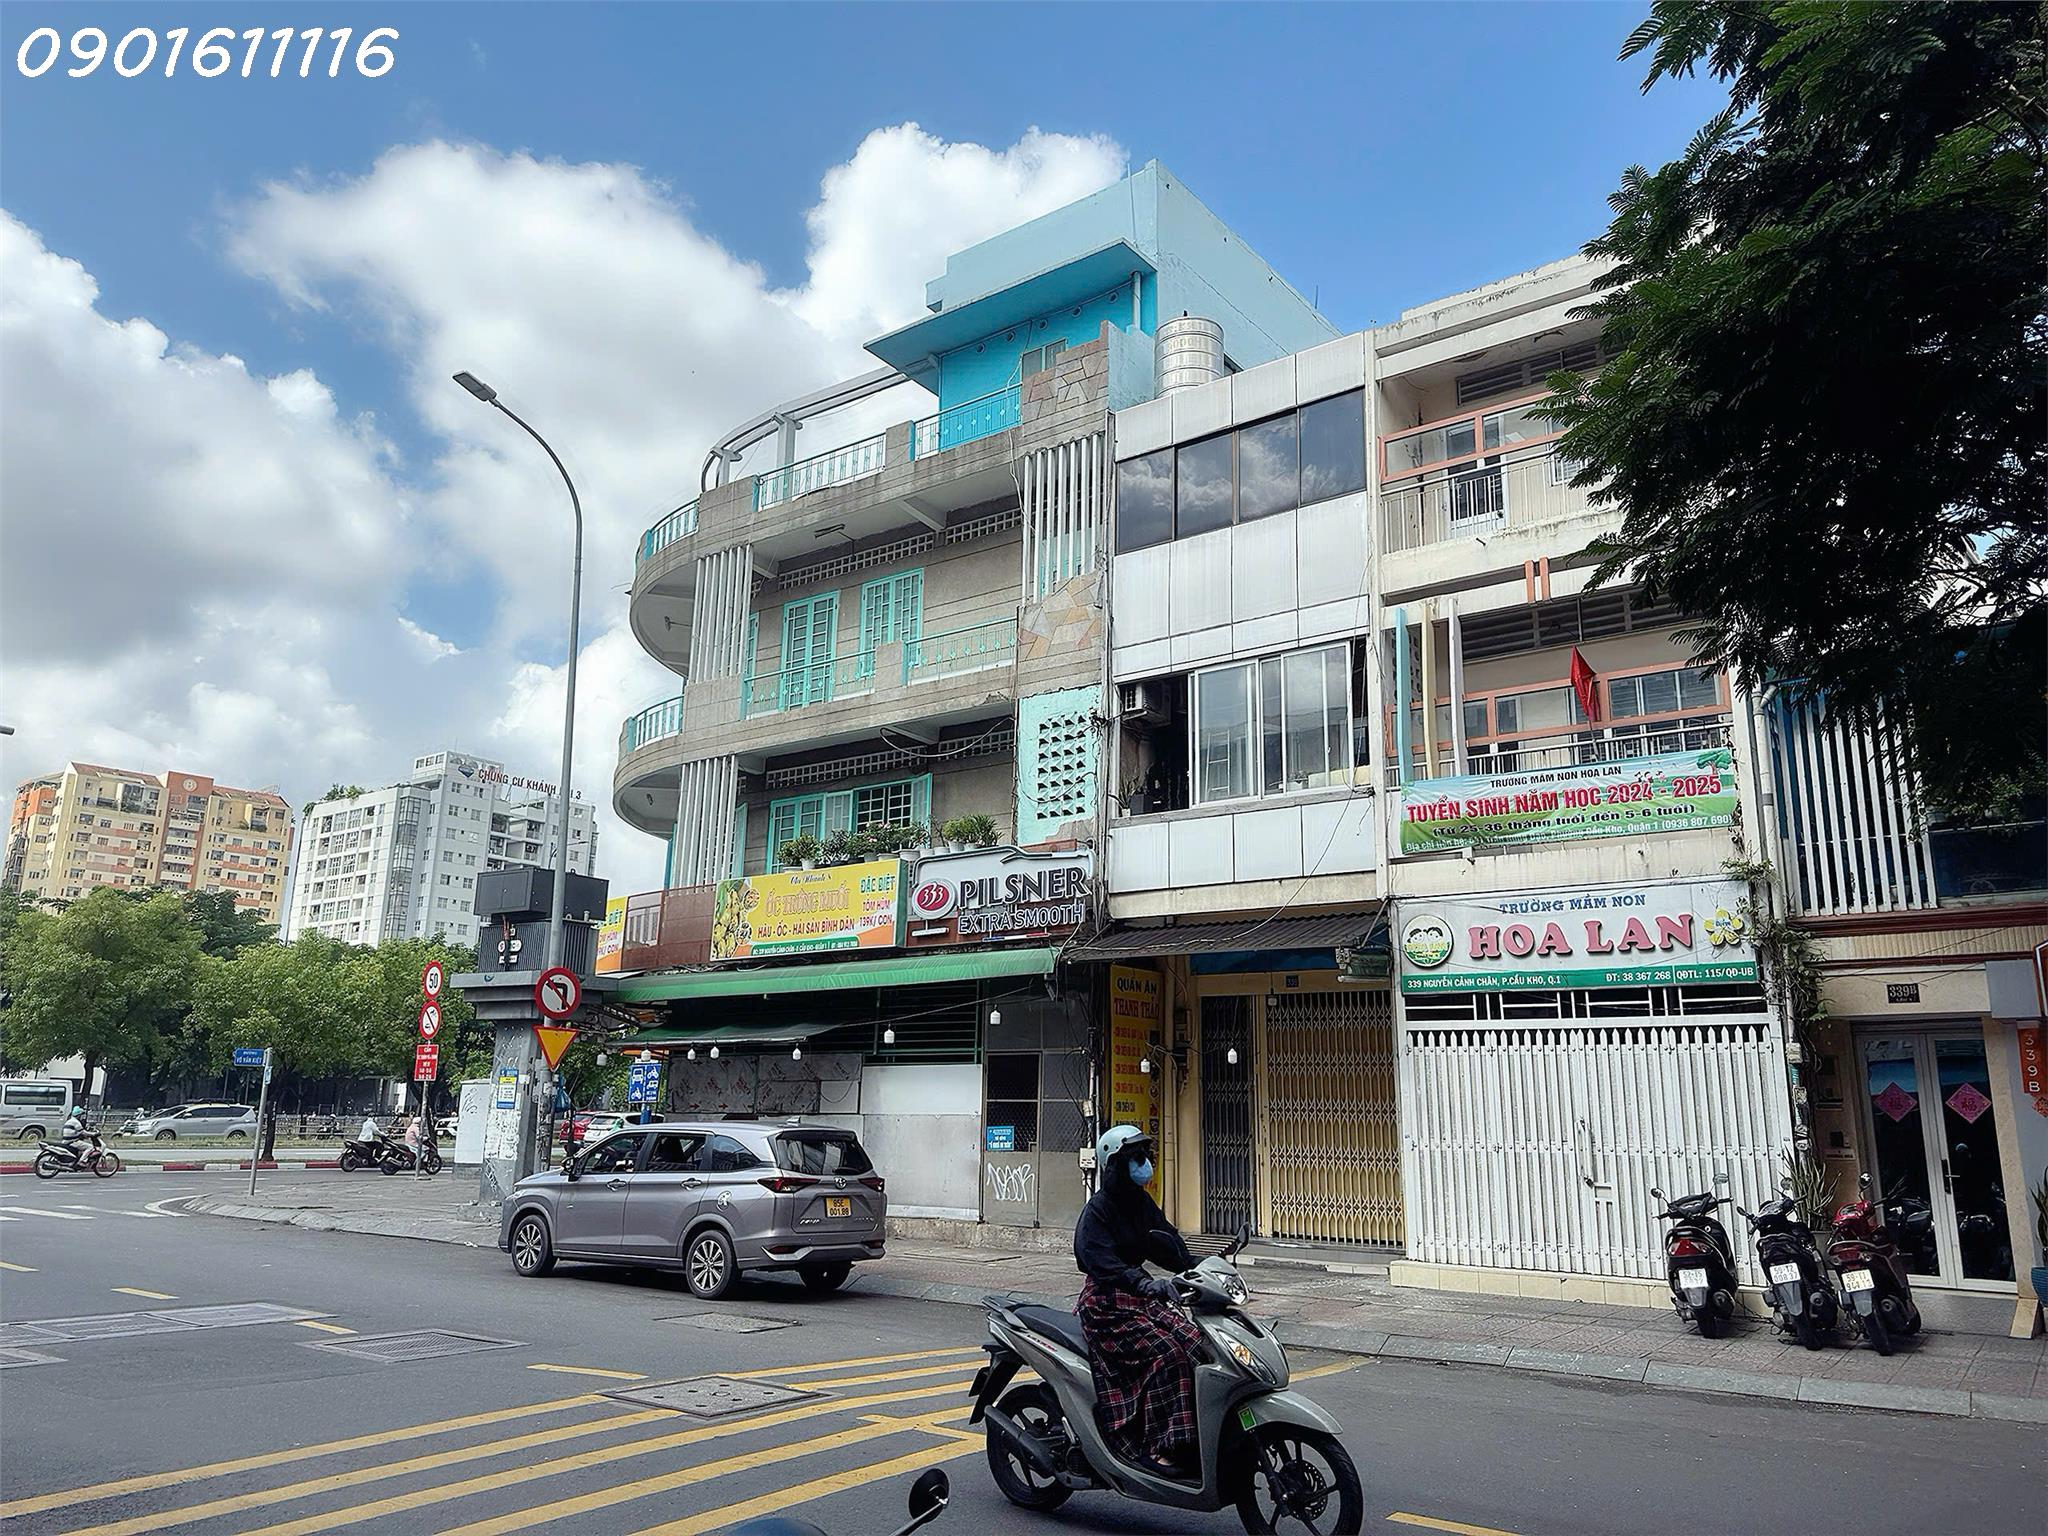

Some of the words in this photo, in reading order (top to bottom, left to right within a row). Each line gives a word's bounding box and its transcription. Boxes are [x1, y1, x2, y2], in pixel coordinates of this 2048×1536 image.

[478, 768, 509, 784] CHUNG
[526, 779, 557, 795] KHÁNH
[1557, 770, 1578, 782] NON
[1580, 768, 1600, 780] HOA
[1602, 765, 1622, 778] LAN
[1406, 794, 1461, 823] TUYỂN
[1465, 796, 1510, 818] SINH
[1514, 788, 1559, 815] NĂM
[1562, 788, 1602, 812] HỌC
[1607, 780, 1654, 804] 2024
[1671, 773, 1722, 799] 2025
[1460, 822, 1503, 834] 25-36
[1625, 808, 1652, 819] 5-6
[1691, 817, 1708, 827] 807
[922, 882, 944, 907] 333
[959, 866, 1093, 909] PILSNER
[1499, 898, 1564, 914] TRƯỜNG
[1611, 893, 1647, 908] NON
[776, 919, 788, 937] ỐC
[958, 910, 1013, 935] EXTRA
[1014, 902, 1086, 928] SMOOTH
[1468, 921, 1573, 961] HOA
[1584, 912, 1695, 955] LAN
[428, 973, 439, 989] 50
[1407, 979, 1422, 989] 339
[1548, 974, 1561, 985] Q.1
[1605, 973, 1620, 982] ĐT:
[1622, 972, 1634, 982] 38
[1636, 971, 1651, 981] 367
[1654, 970, 1671, 980] 268
[1889, 985, 1917, 998] 339B
